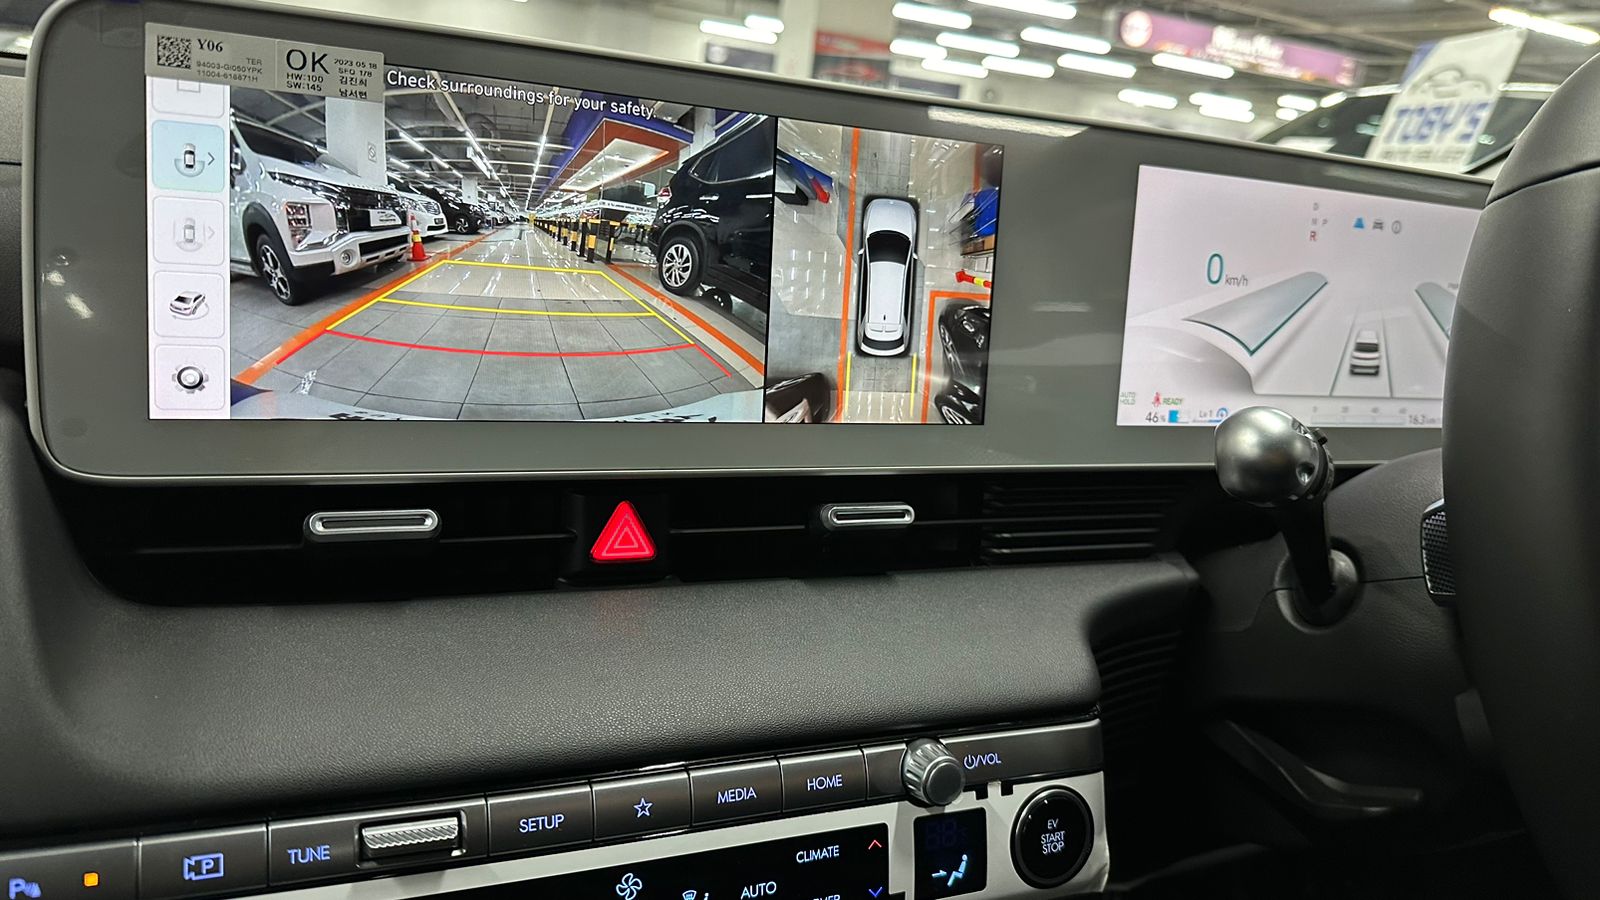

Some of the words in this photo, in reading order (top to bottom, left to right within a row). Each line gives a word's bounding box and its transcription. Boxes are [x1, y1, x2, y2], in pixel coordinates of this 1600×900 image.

[197, 38, 223, 53] Y06
[246, 57, 263, 66] TER
[286, 49, 330, 75] OK
[286, 72, 324, 83] HW:100
[286, 80, 322, 92] SW:145
[387, 70, 436, 90] Check
[440, 79, 544, 105] surroundings
[549, 91, 570, 106] for
[574, 96, 607, 111] your
[610, 101, 657, 119] safety.
[1309, 230, 1317, 241] R
[1207, 253, 1224, 285] 0
[1224, 274, 1249, 287] km/h
[1162, 397, 1185, 405] READY
[1145, 411, 1159, 423] 46
[807, 774, 843, 792] HOME
[717, 786, 757, 804] MEDIA
[519, 813, 565, 833] SETUP
[1047, 819, 1059, 829] EV
[1040, 830, 1065, 845] START
[287, 844, 331, 865] TUNE
[796, 845, 840, 863] CLIMATE
[1042, 841, 1065, 855] STOP
[740, 881, 777, 900] AUTO
